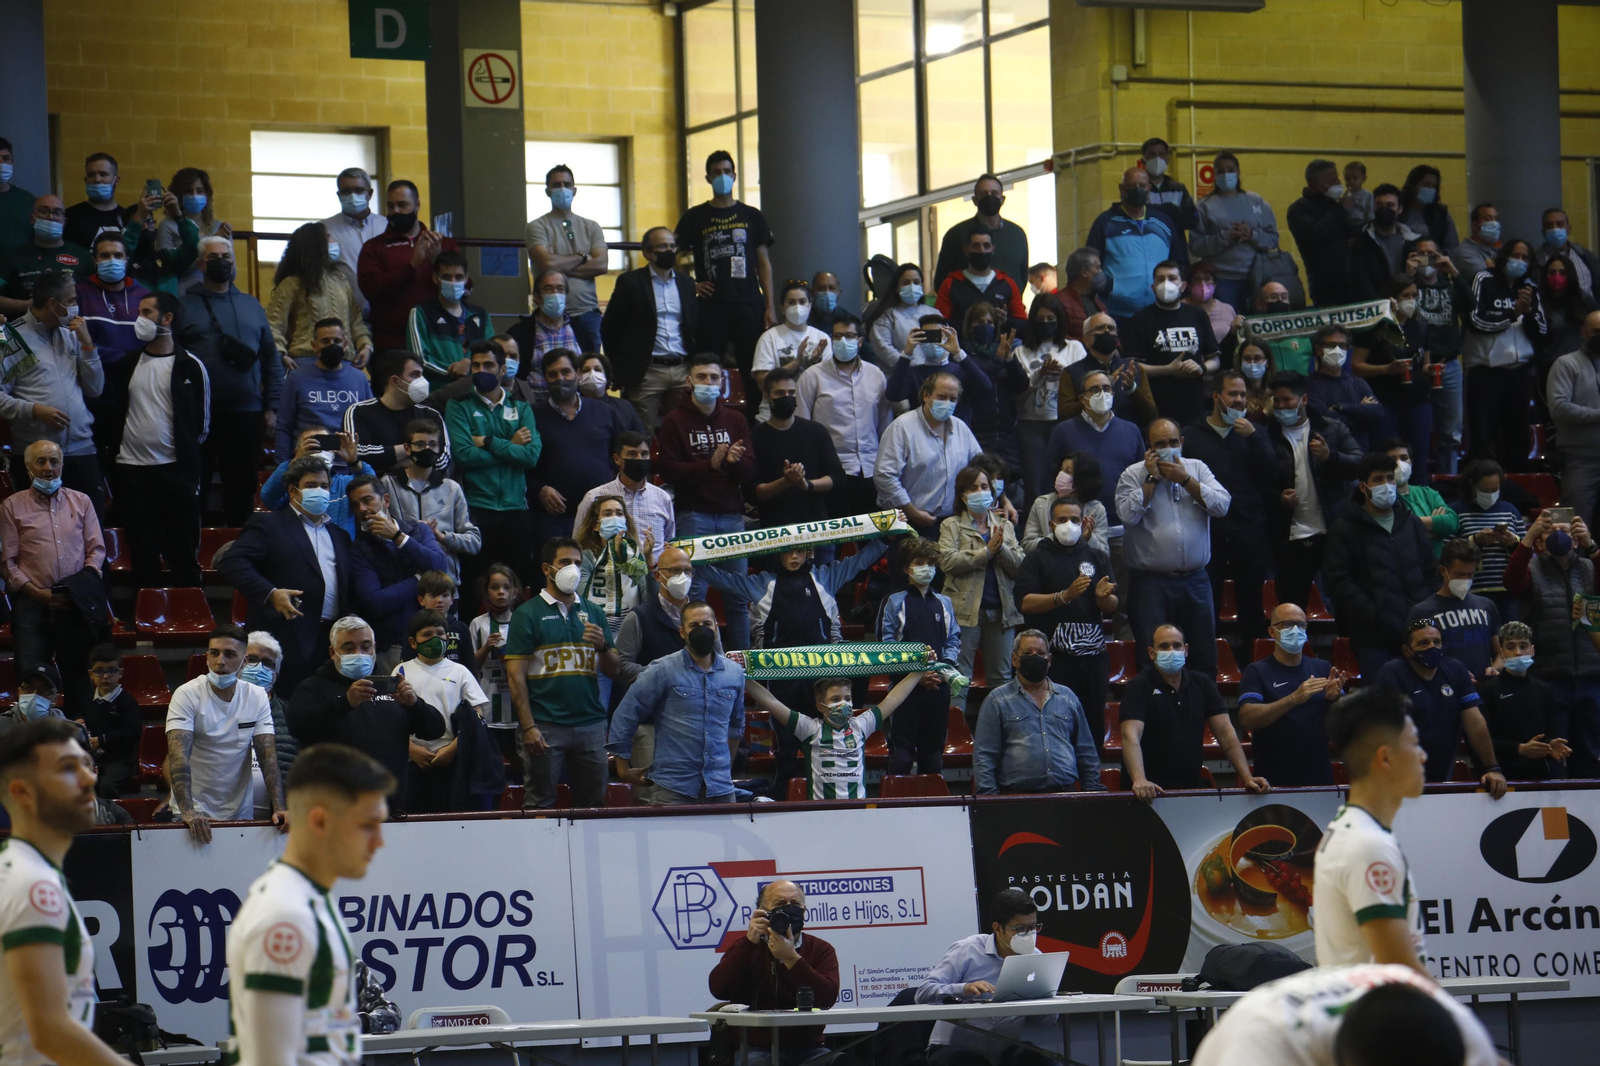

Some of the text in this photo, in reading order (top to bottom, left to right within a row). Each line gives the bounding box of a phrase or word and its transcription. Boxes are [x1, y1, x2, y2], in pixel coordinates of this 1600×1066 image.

[374, 8, 407, 48] D
[1329, 306, 1384, 325] FUTSAL
[1494, 299, 1516, 310] adi
[308, 390, 358, 402] SILBON
[797, 516, 864, 534] FUTSAL
[744, 536, 792, 550] PATRIMONIO
[819, 526, 864, 538] HUMANIDAD
[592, 567, 606, 598] FUT
[1434, 608, 1489, 630] TOMMY
[797, 879, 891, 895] TRUCCIONES
[1008, 871, 1130, 884] PASTELERIA
[1009, 882, 1133, 912] OLDAN
[338, 889, 534, 933] BINADOS
[803, 900, 838, 923] onilla
[842, 906, 850, 920] e
[855, 901, 894, 925] Hijos,
[1420, 894, 1600, 935] El Arcán
[361, 934, 564, 993] STOR S.L.
[444, 1016, 489, 1027] IMDECO
